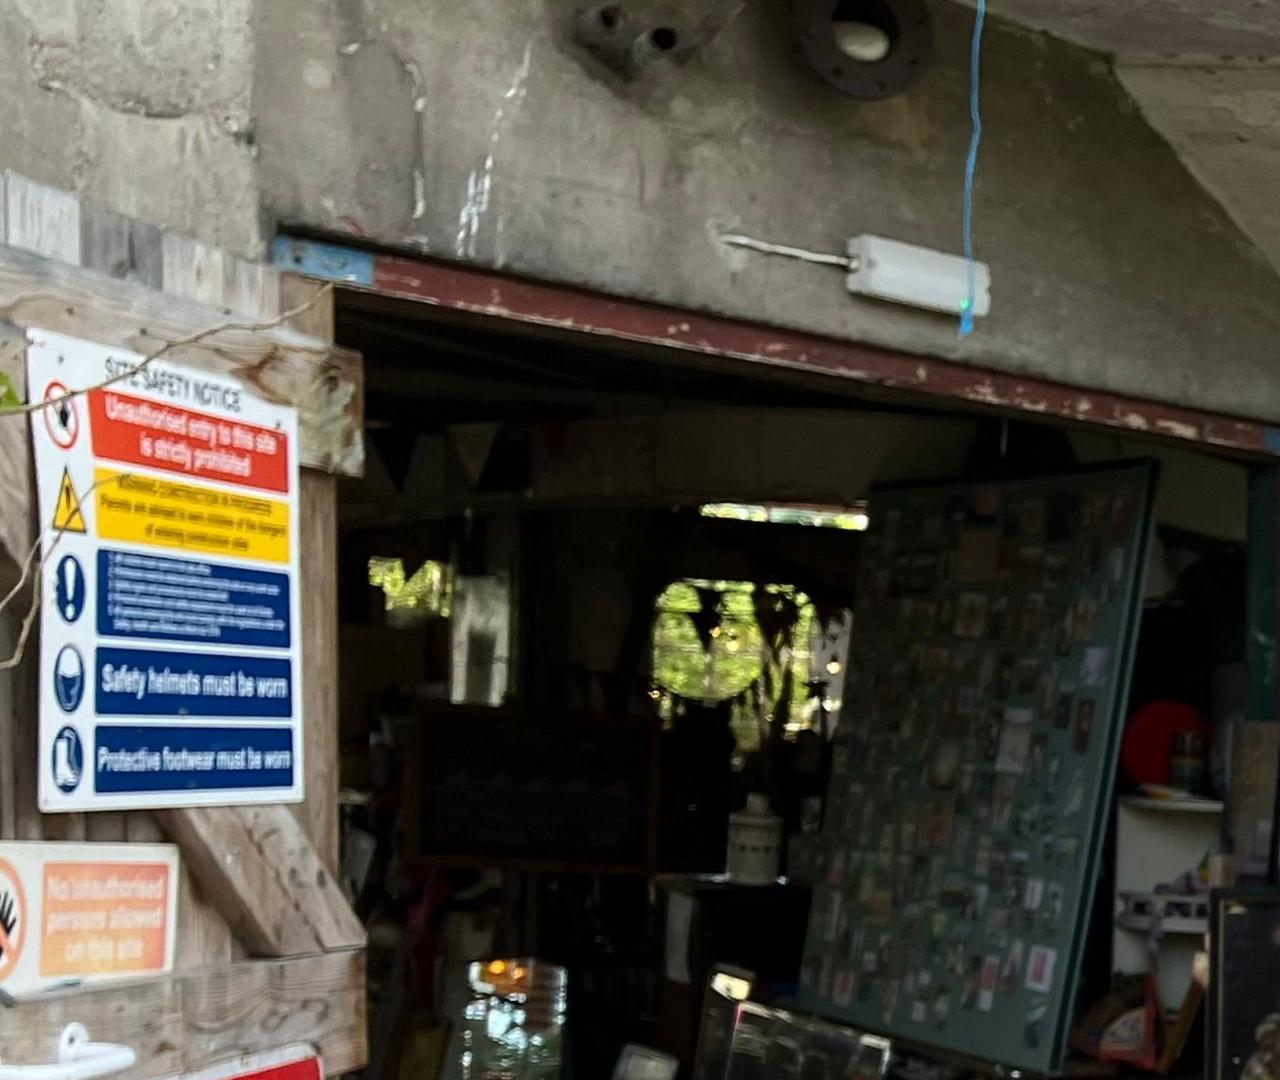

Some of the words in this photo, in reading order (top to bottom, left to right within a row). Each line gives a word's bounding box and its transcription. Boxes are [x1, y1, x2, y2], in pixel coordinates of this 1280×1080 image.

[143, 364, 190, 398] SAFETY
[193, 381, 241, 412] NOTICE
[102, 663, 146, 700] Safety
[148, 666, 200, 696] helmets
[202, 671, 236, 697] must
[237, 670, 255, 697] be
[256, 677, 288, 698] worn
[97, 746, 161, 772] Protective
[162, 745, 215, 772] footwear
[216, 747, 246, 771] must
[247, 746, 262, 770] be
[263, 750, 291, 770] worn
